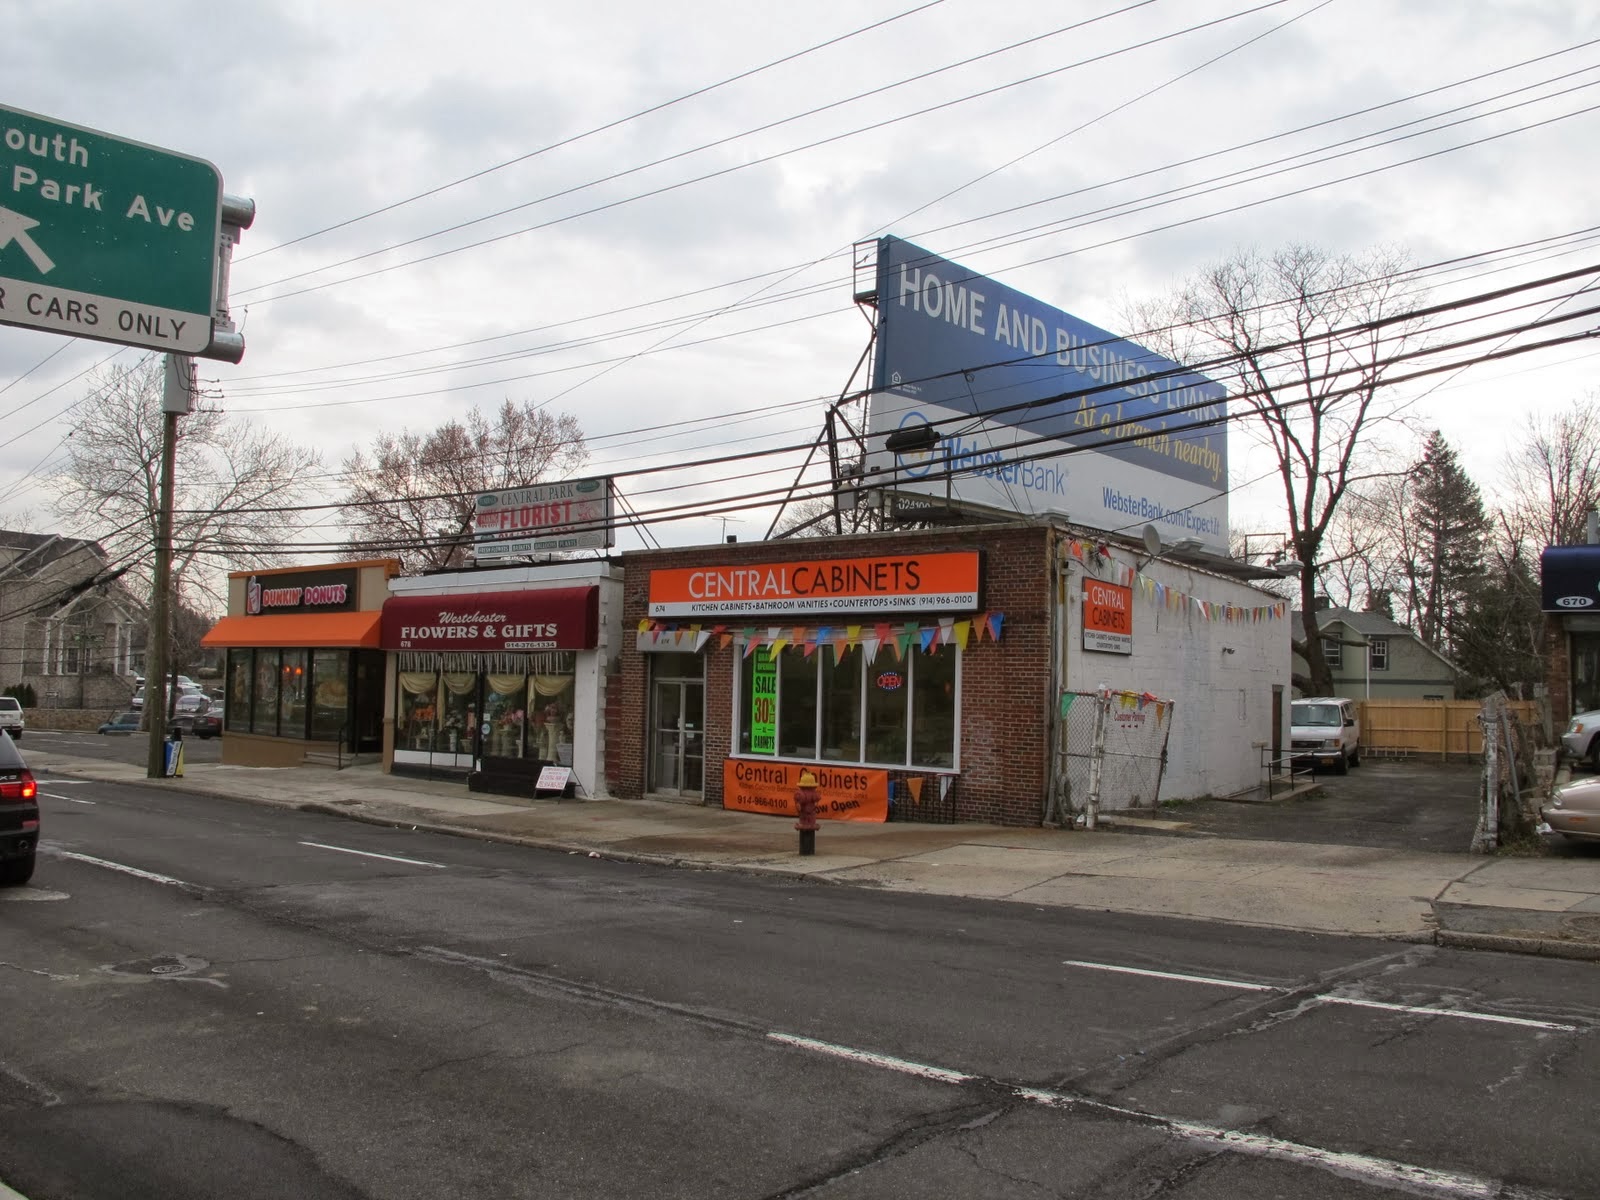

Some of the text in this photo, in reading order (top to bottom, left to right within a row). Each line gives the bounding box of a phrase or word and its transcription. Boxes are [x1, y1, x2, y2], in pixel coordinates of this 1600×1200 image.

[5, 128, 89, 168] outh
[13, 165, 195, 232] Park Ave
[27, 293, 99, 325] CARS
[118, 310, 186, 340] ONLY
[900, 263, 1221, 422] HOME AND BUSINESS LOANS
[1074, 395, 1222, 482] At a branch nearby.
[502, 488, 547, 506] CENTRAL
[549, 484, 575, 500] PARK
[500, 500, 573, 529] FLORIST
[262, 584, 347, 607] DUNKIN' DONUTS
[655, 605, 666, 613] 674
[691, 603, 718, 611] KITCHEN
[796, 599, 829, 609] VANITIES
[1091, 585, 1125, 610] CENTRAL
[1562, 598, 1587, 606] 670
[438, 610, 507, 625] Westchester
[1092, 606, 1126, 630] CABINETS
[401, 623, 558, 640] FLOWERS & GIFTS
[400, 640, 412, 648] 678
[755, 675, 776, 694] SALE
[735, 762, 788, 785] Central
[815, 804, 828, 814] ow
[831, 800, 860, 813] Open
